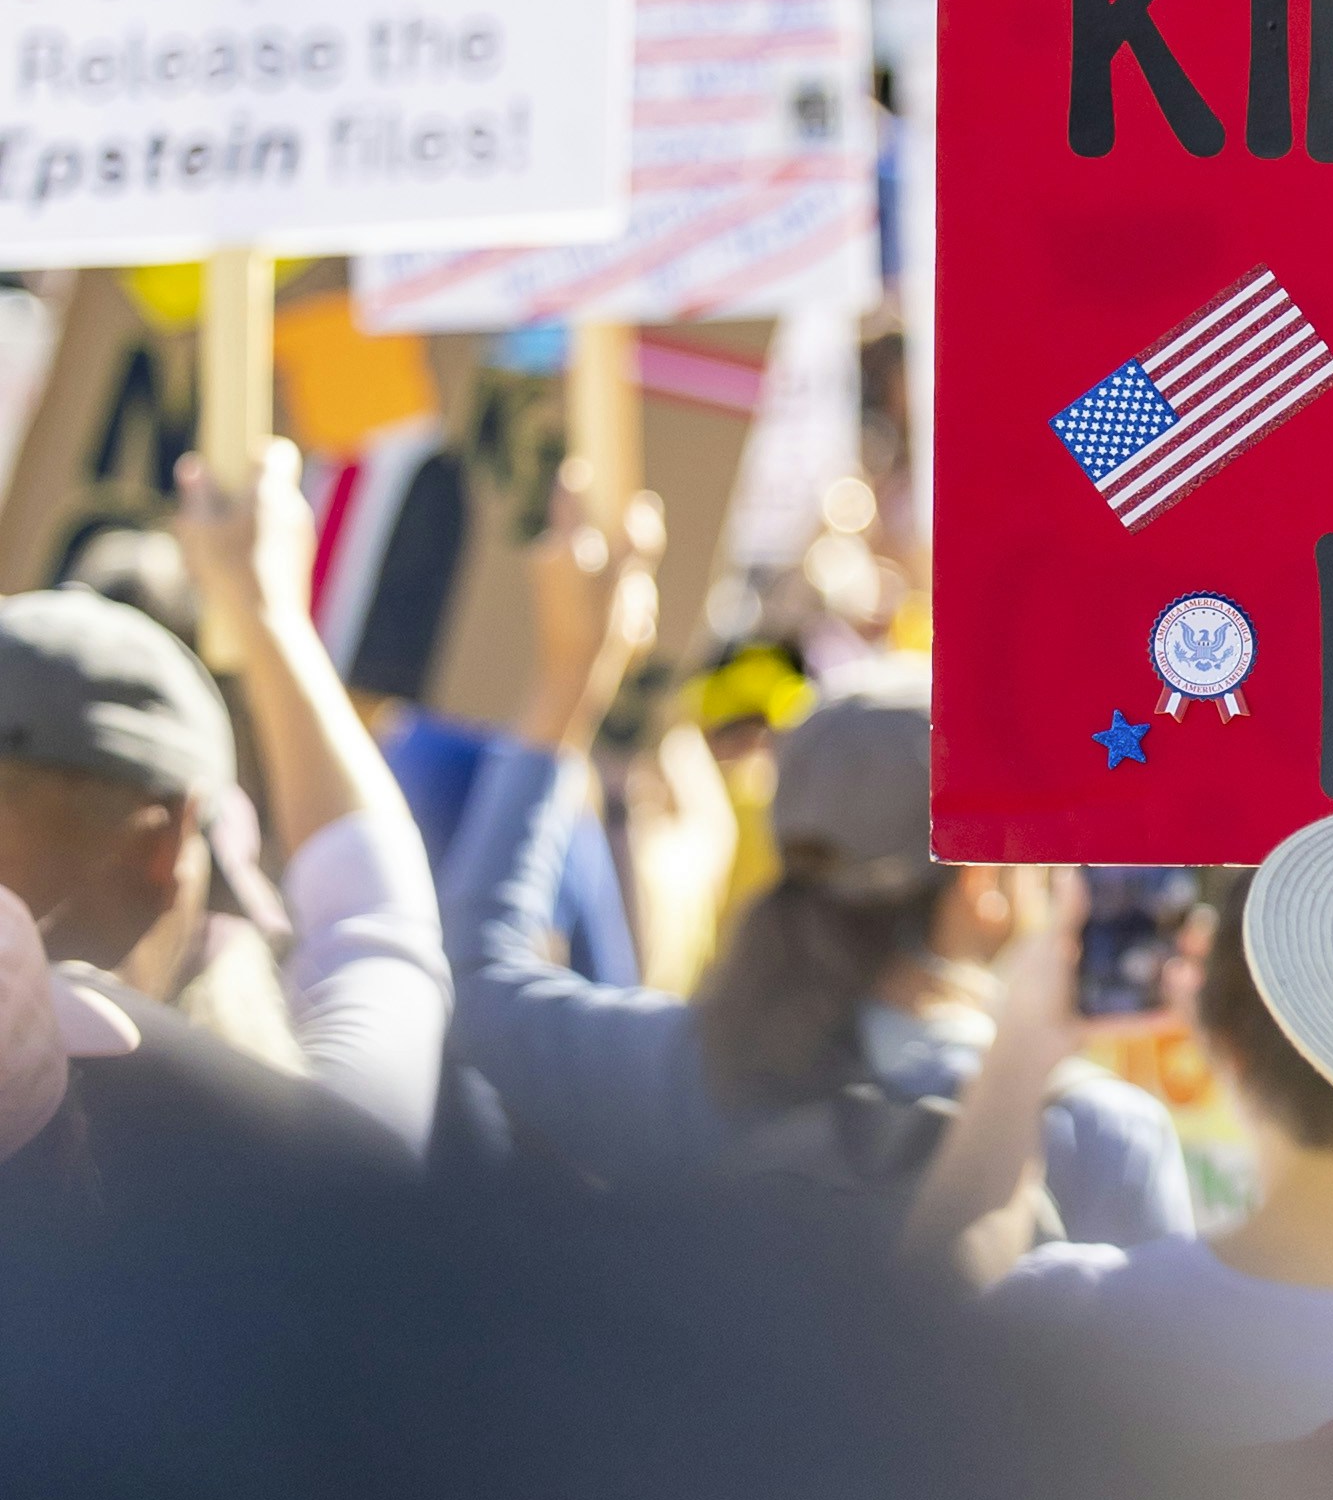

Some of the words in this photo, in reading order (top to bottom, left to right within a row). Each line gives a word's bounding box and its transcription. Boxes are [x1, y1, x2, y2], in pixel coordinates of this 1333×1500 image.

[20, 22, 344, 104] Release
[368, 14, 504, 83] the
[327, 98, 532, 184] files!
[1156, 608, 1183, 643] AMERICA
[1183, 599, 1224, 611] AMERICA
[1225, 608, 1251, 643] AMERICA
[1156, 650, 1181, 686] AMERICA
[1182, 684, 1225, 694] AMERICA
[1225, 651, 1251, 686] AMERICA
